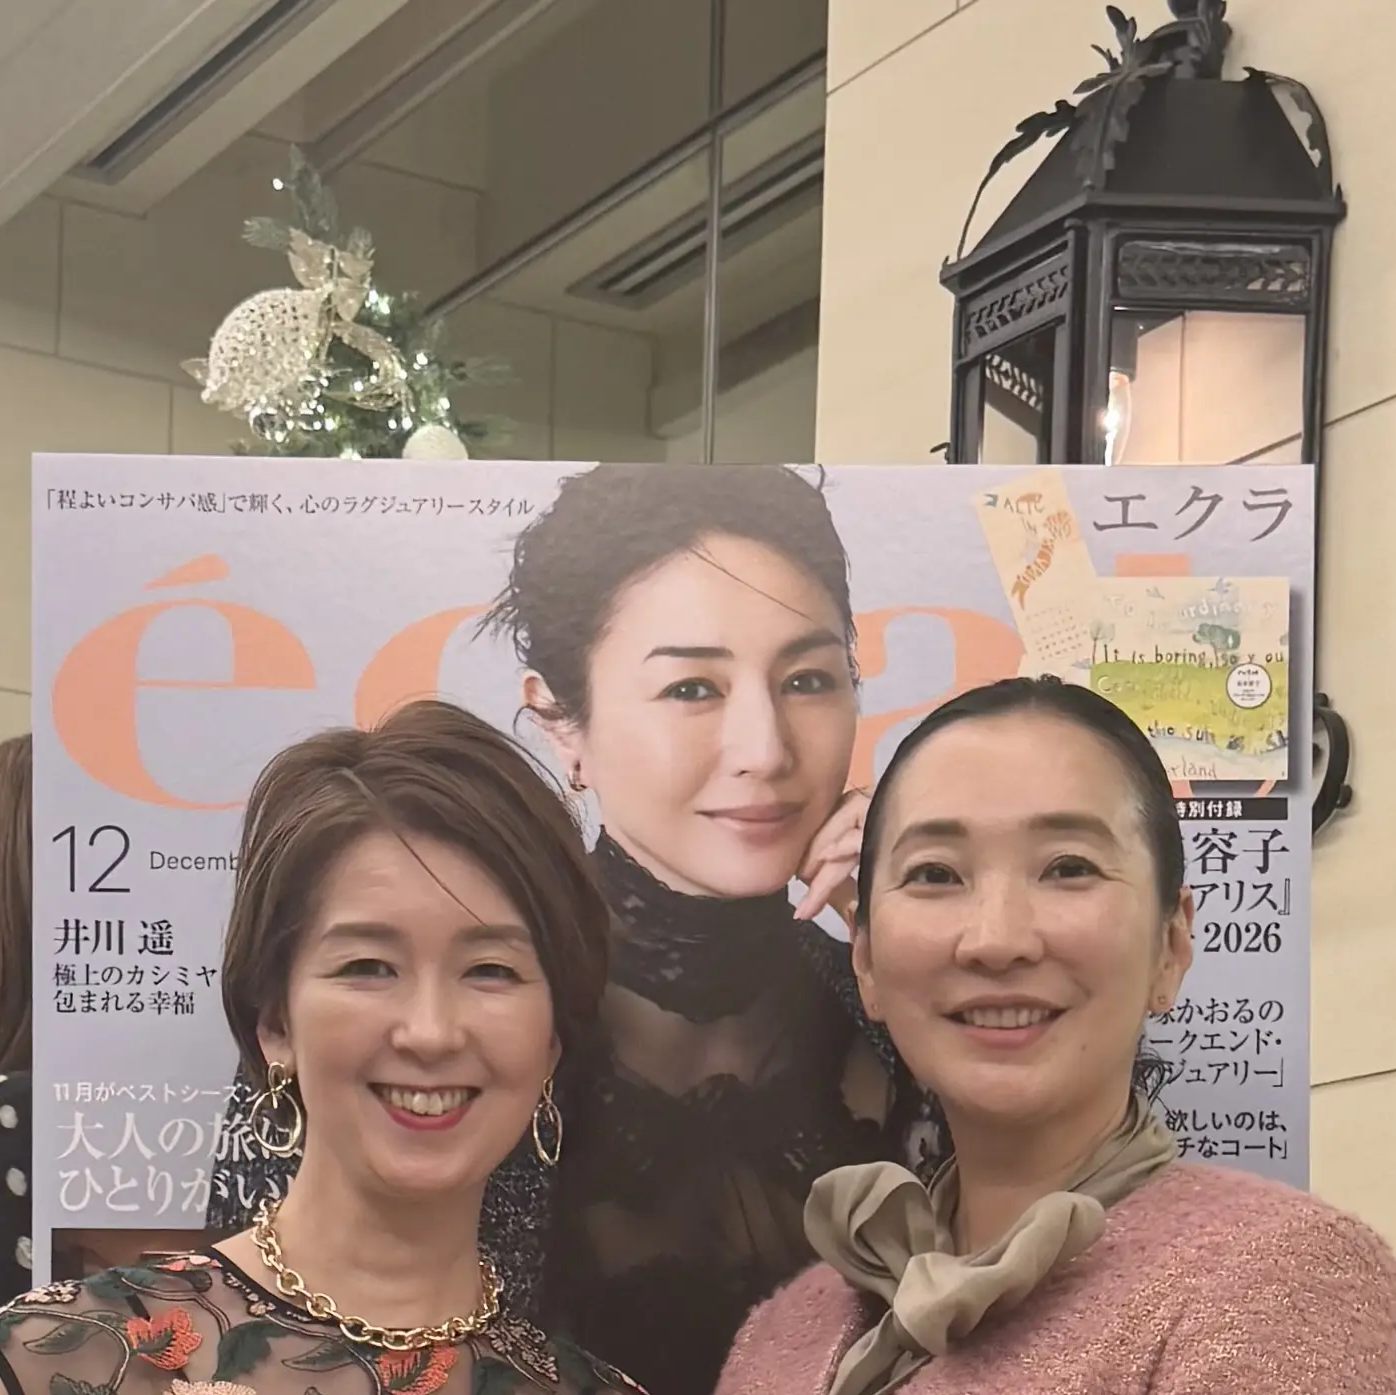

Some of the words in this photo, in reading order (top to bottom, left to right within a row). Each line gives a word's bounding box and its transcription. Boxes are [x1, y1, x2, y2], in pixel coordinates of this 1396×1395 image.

[1092, 485, 1294, 541] エクラ
[52, 825, 131, 893] 12
[1203, 921, 1282, 953] 2026
[52, 963, 218, 987] 極上のカシミヤ
[53, 991, 195, 1015] 包まれる幸福
[53, 1081, 261, 1103] 11月がベストシーズン
